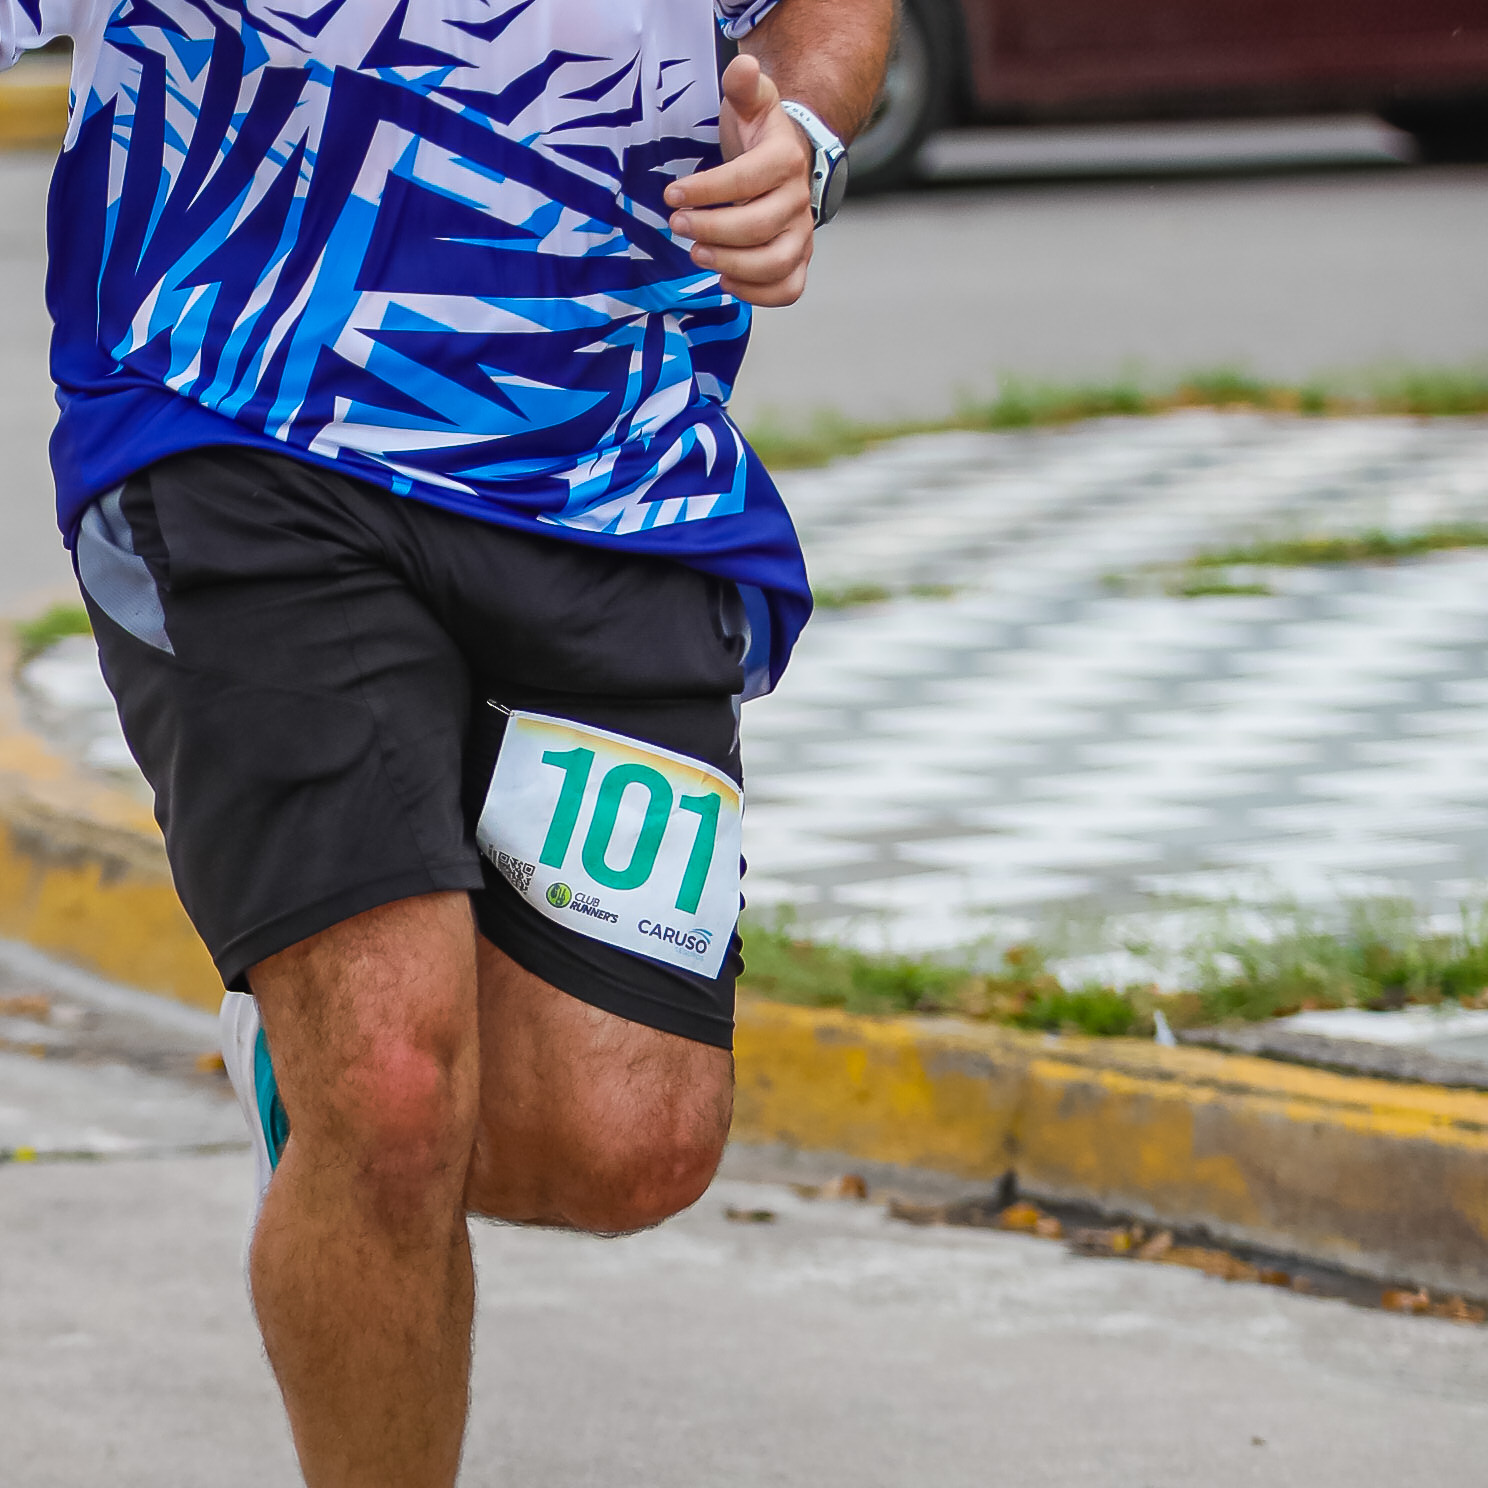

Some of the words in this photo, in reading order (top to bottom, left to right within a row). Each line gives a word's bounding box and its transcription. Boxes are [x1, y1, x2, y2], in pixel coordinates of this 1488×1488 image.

[538, 747, 721, 915] 101
[569, 900, 619, 924] RUNNER'S
[574, 892, 601, 908] CLUB
[637, 919, 708, 954] CARUSO
